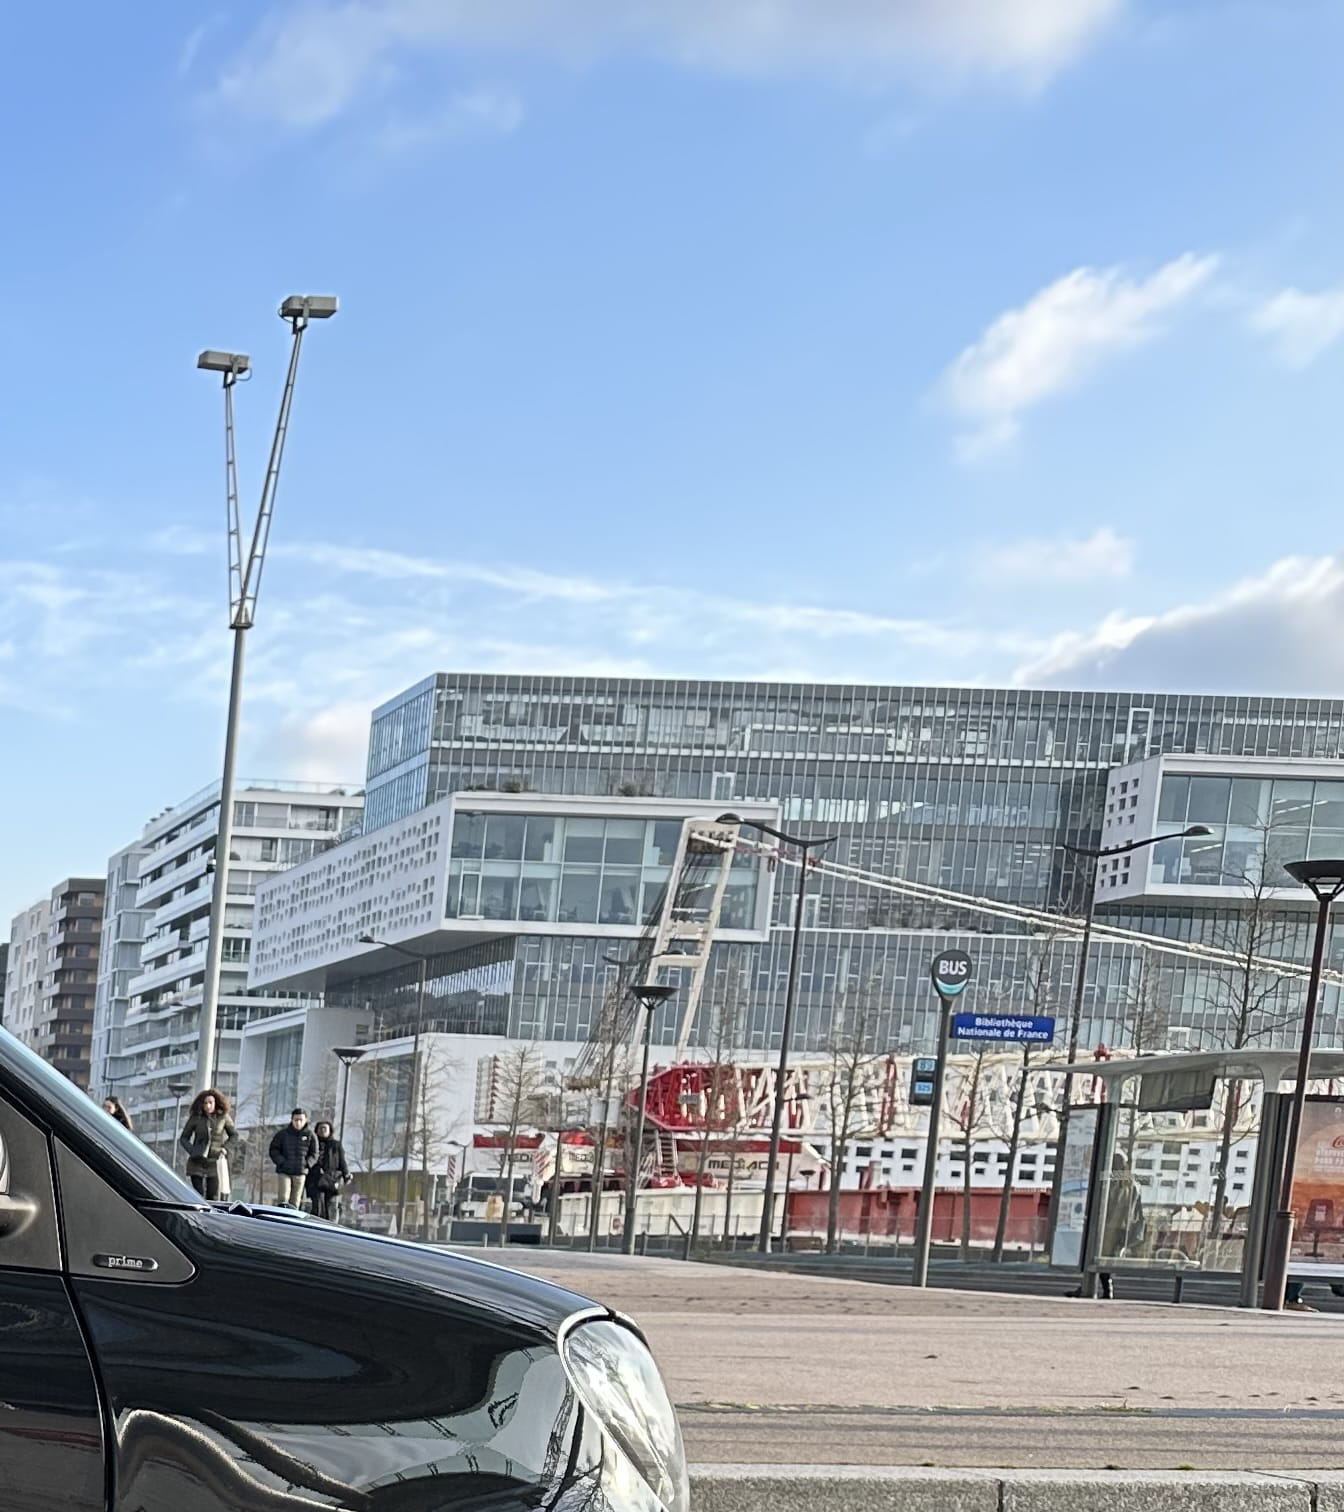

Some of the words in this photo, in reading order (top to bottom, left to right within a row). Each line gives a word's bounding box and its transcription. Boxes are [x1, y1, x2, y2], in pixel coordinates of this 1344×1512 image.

[938, 960, 968, 976] BUS
[975, 1017, 1034, 1029] Bibliothèque
[957, 1026, 1002, 1038] Nationale
[1003, 1028, 1015, 1038] de
[1017, 1029, 1049, 1040] France
[108, 1256, 143, 1268] prime
